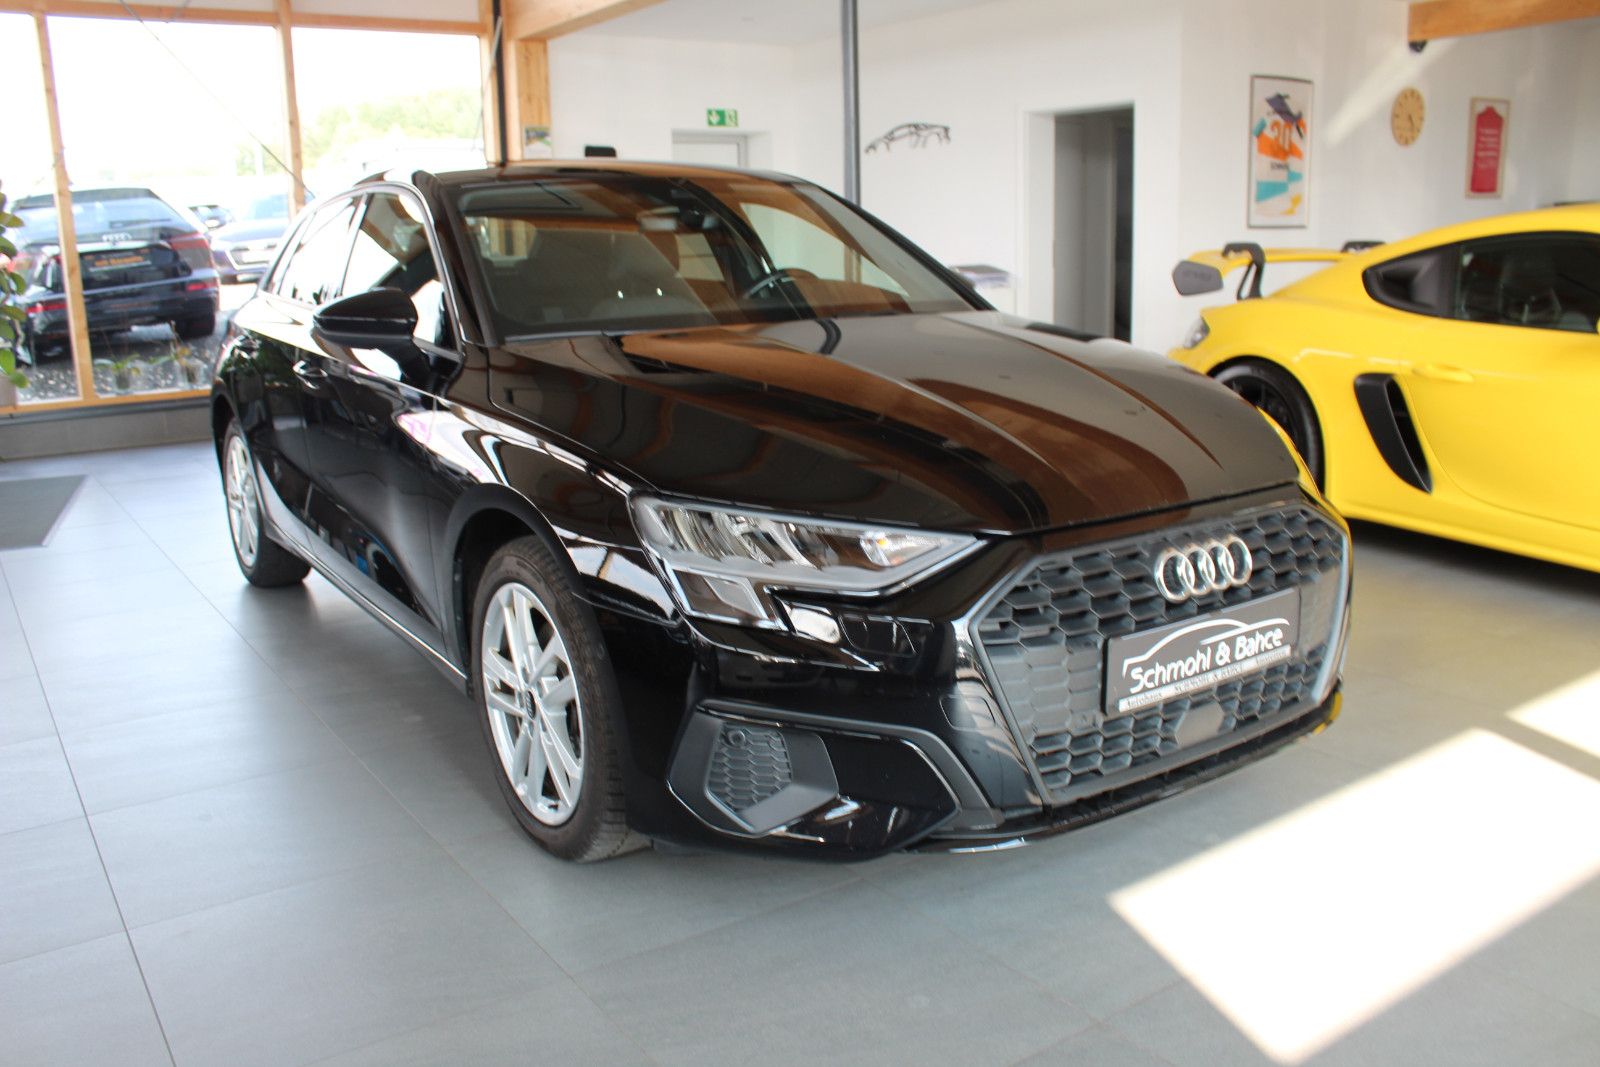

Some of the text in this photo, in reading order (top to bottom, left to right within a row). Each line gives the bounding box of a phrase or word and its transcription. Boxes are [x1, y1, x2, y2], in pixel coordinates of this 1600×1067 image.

[1130, 646, 1212, 693] Schmohl
[1216, 641, 1231, 666] &
[1235, 628, 1283, 661] Bahce
